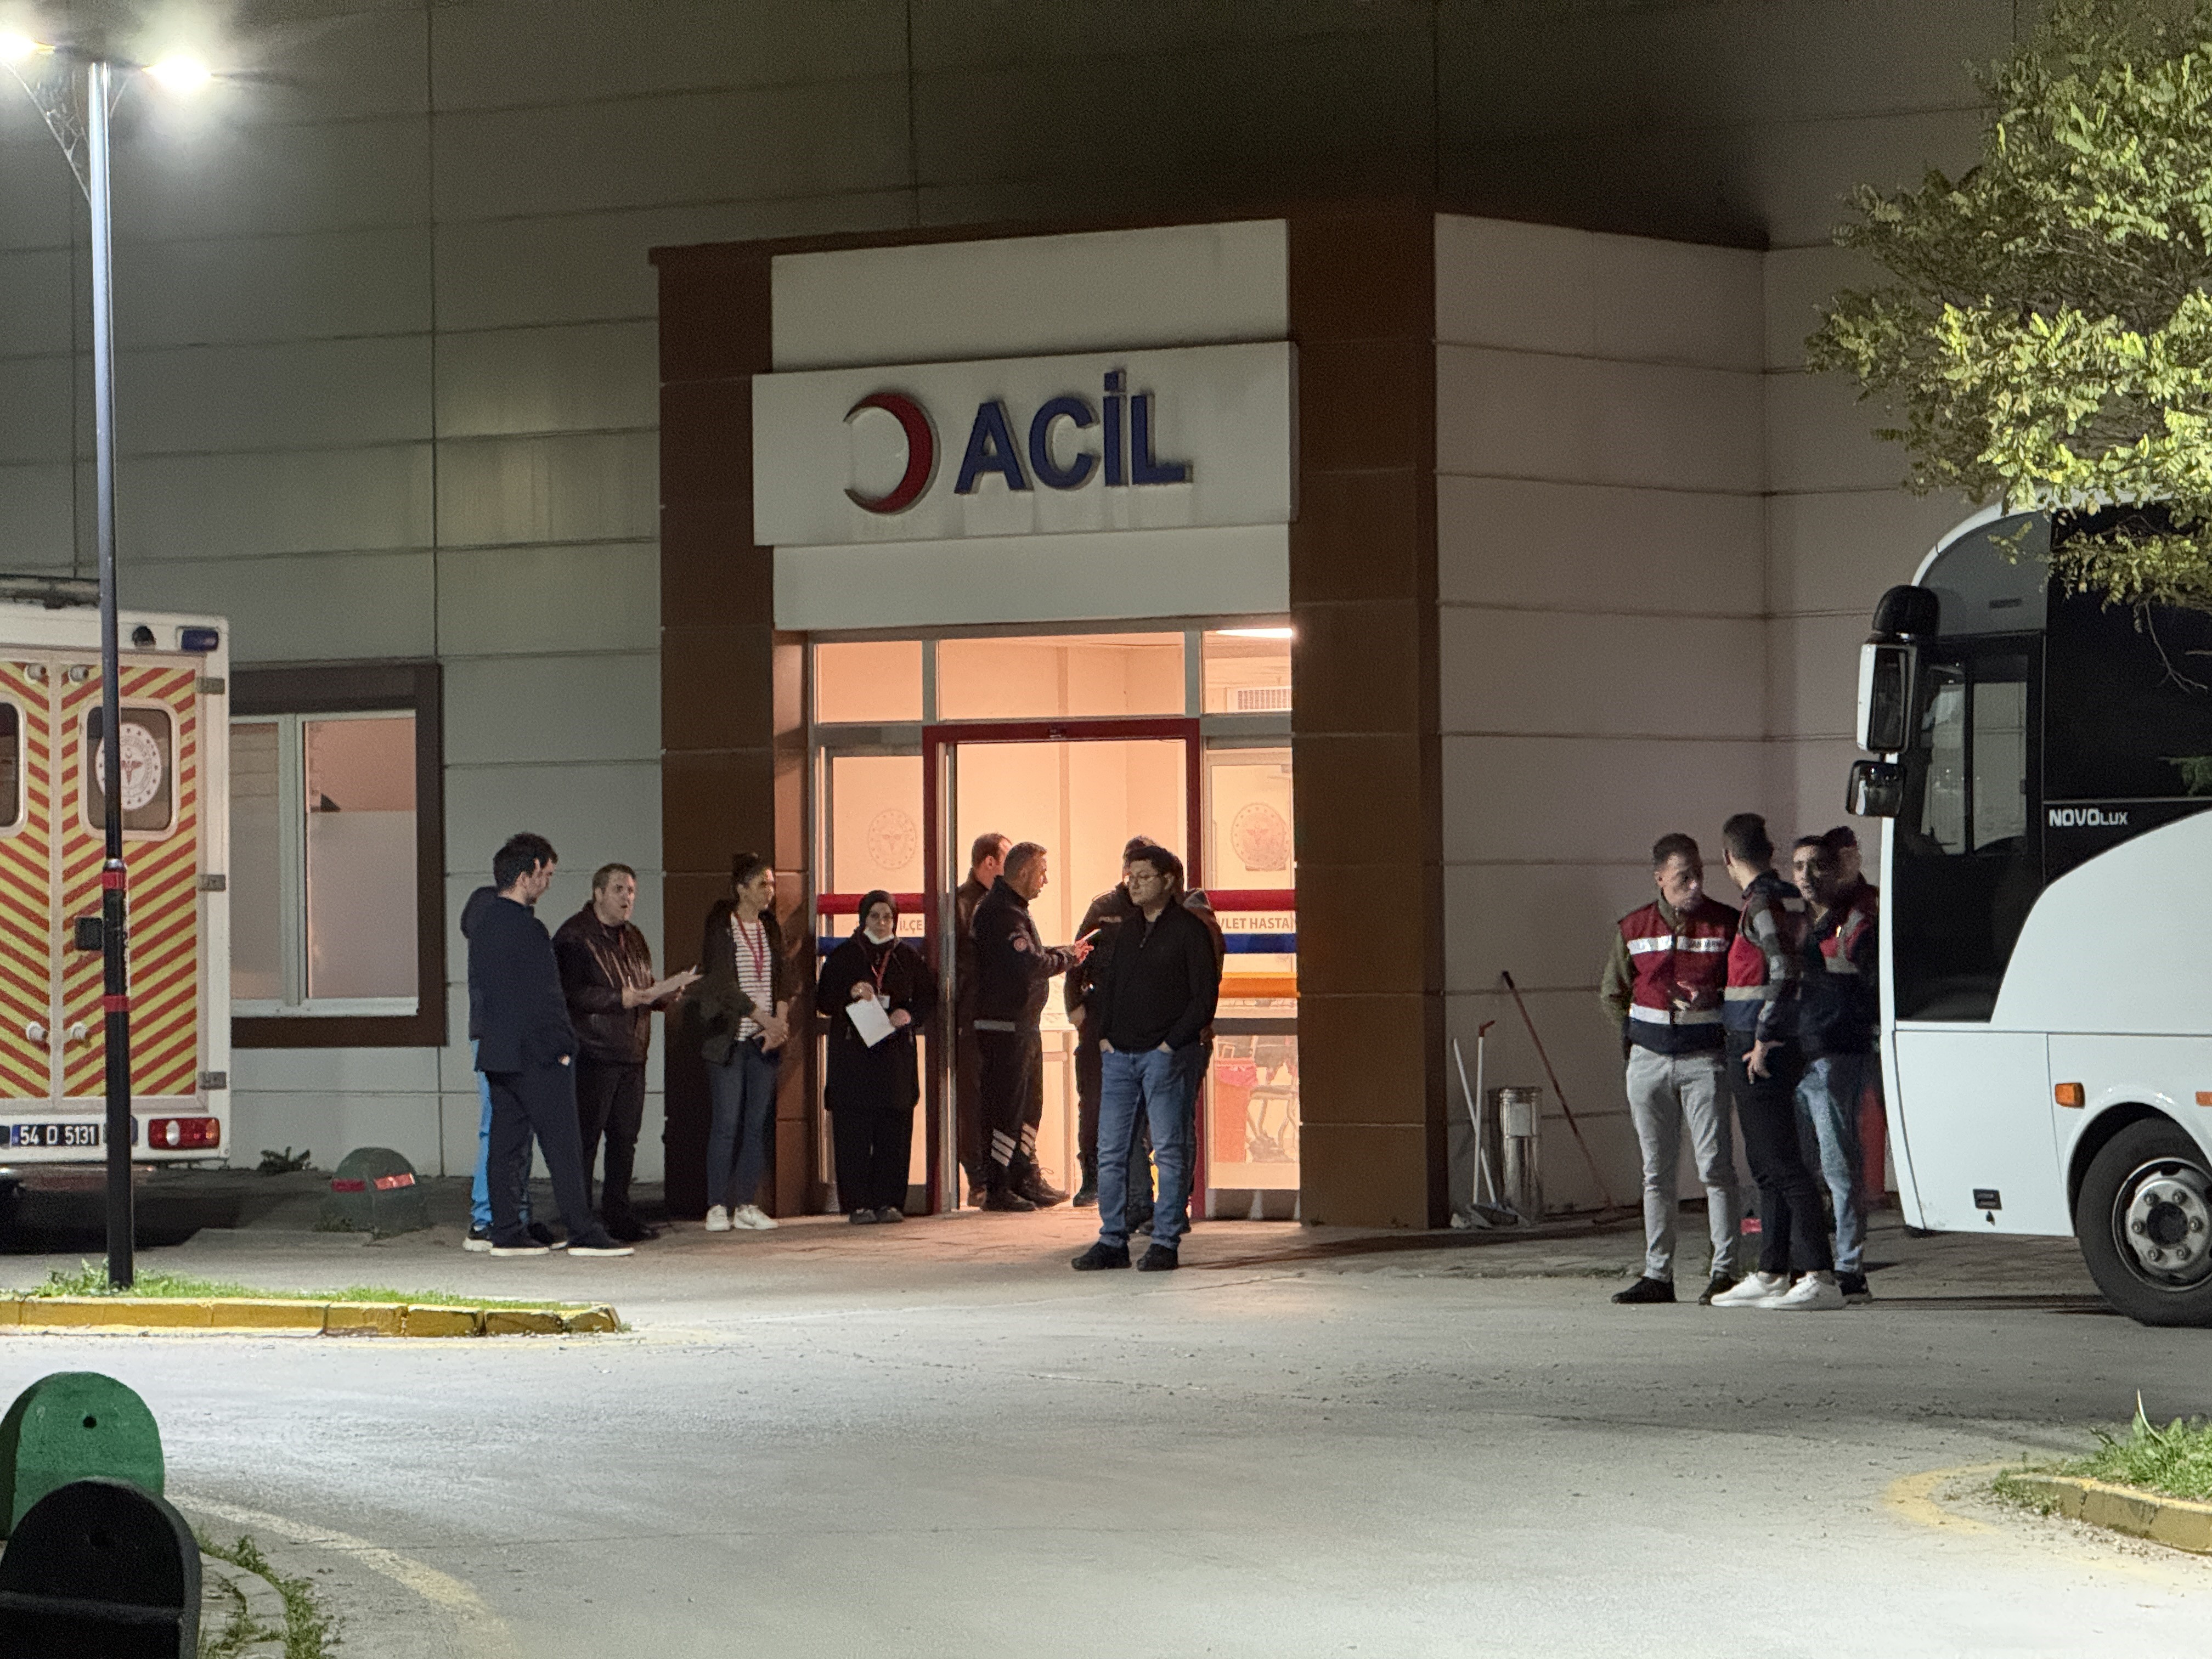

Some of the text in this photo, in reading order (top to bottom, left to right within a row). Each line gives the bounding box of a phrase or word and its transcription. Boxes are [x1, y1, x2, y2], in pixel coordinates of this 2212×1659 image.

[954, 368, 1193, 494] ACİL
[2049, 808, 2128, 827] NOVOLUX
[899, 917, 922, 934] İLÇE
[20, 1126, 39, 1145] 54
[65, 1126, 95, 1145] 5131
